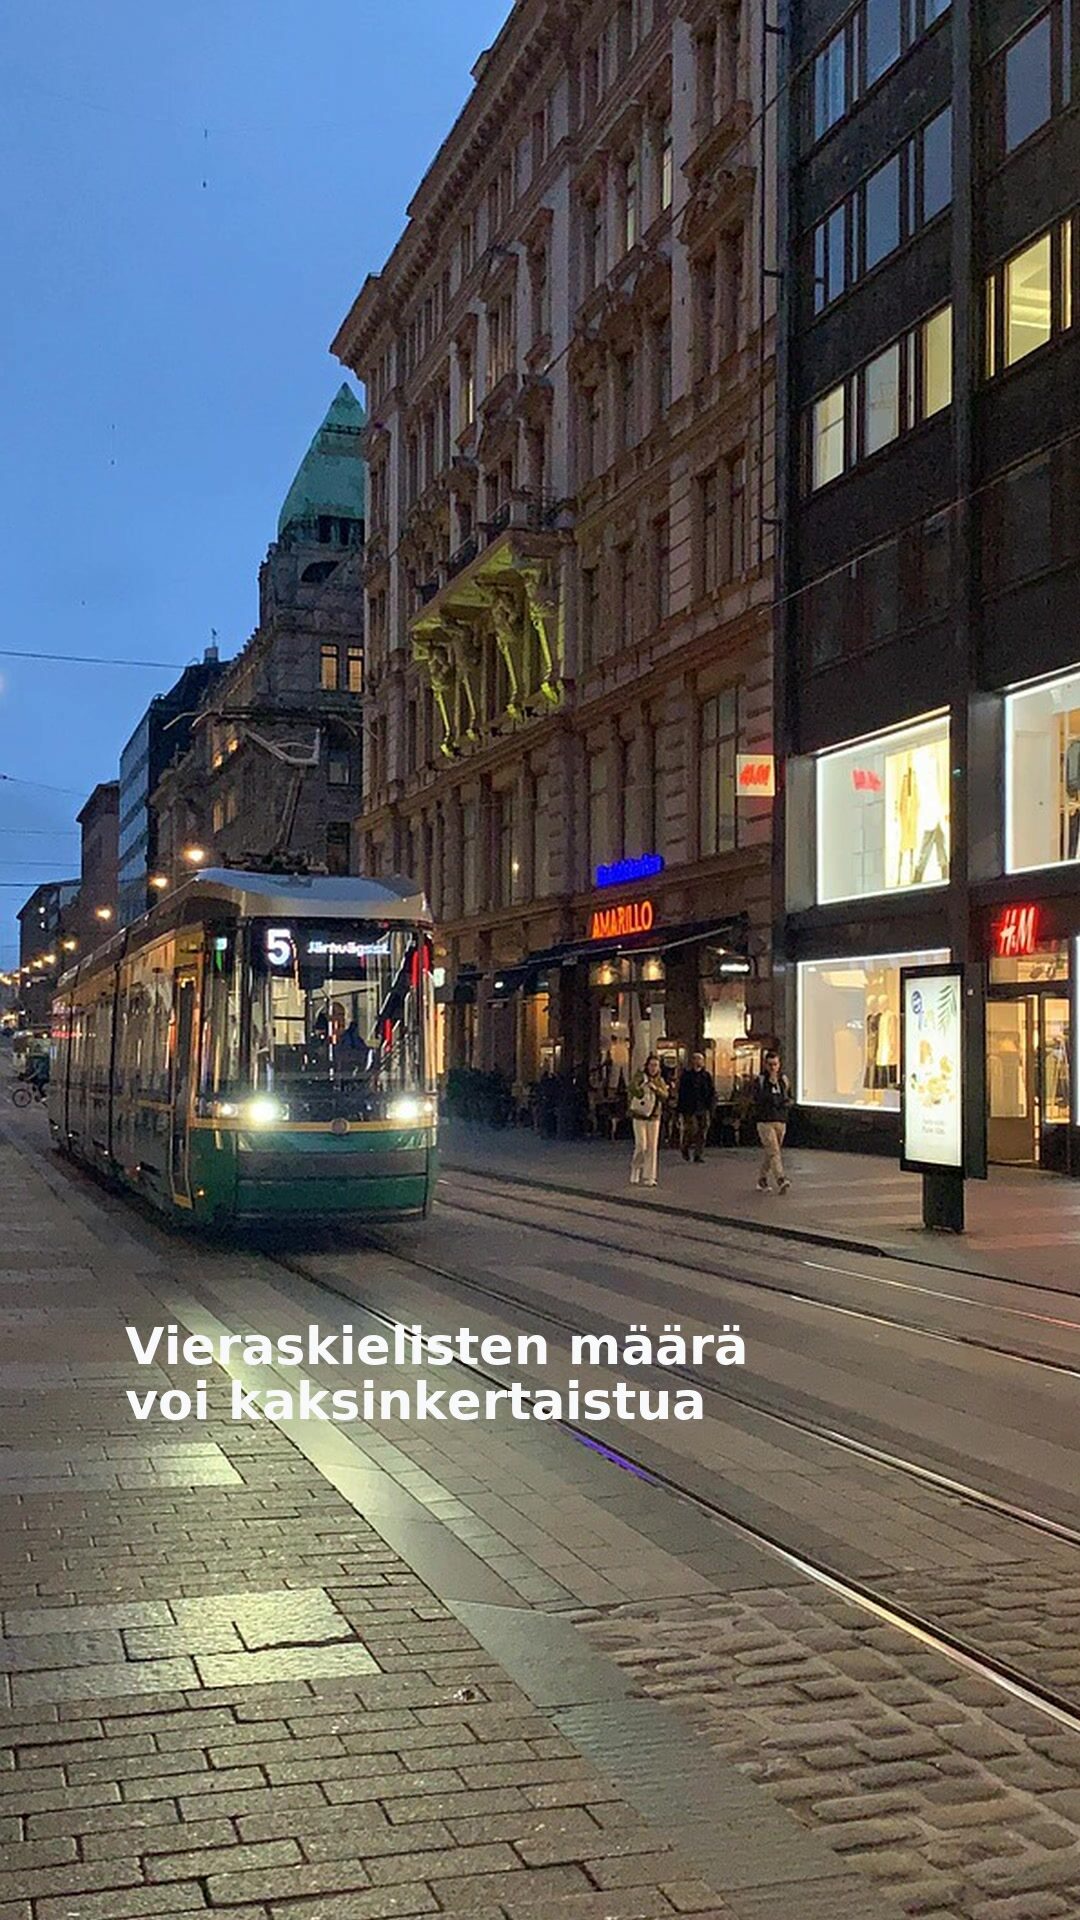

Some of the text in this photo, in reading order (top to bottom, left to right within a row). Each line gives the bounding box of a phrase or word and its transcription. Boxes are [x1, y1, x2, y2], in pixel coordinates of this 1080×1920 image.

[592, 901, 653, 939] AMARILLO
[1000, 906, 1036, 955] H&M
[267, 928, 291, 965] 5
